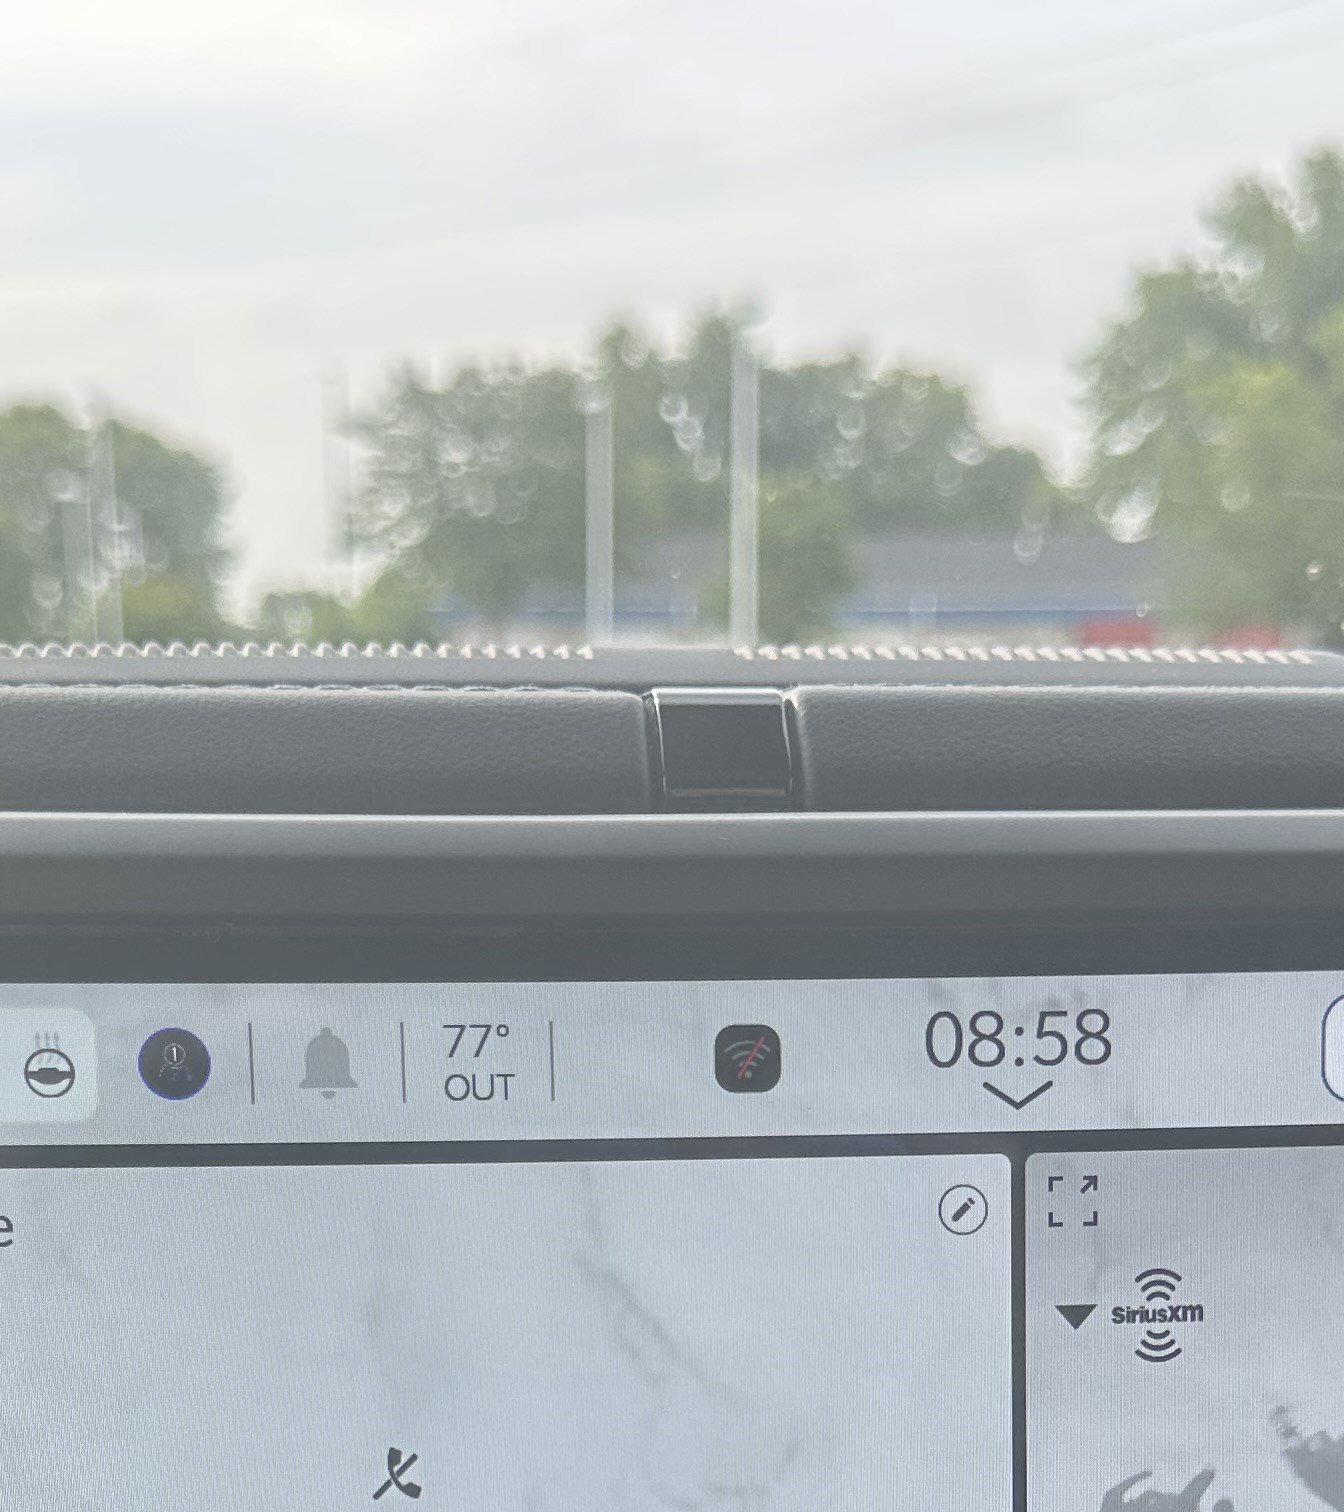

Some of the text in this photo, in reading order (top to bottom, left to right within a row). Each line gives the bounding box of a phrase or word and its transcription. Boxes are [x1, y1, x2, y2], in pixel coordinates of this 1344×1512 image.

[443, 1023, 510, 1059] 77°
[924, 1008, 1113, 1070] 08:58
[443, 1073, 516, 1101] OUT
